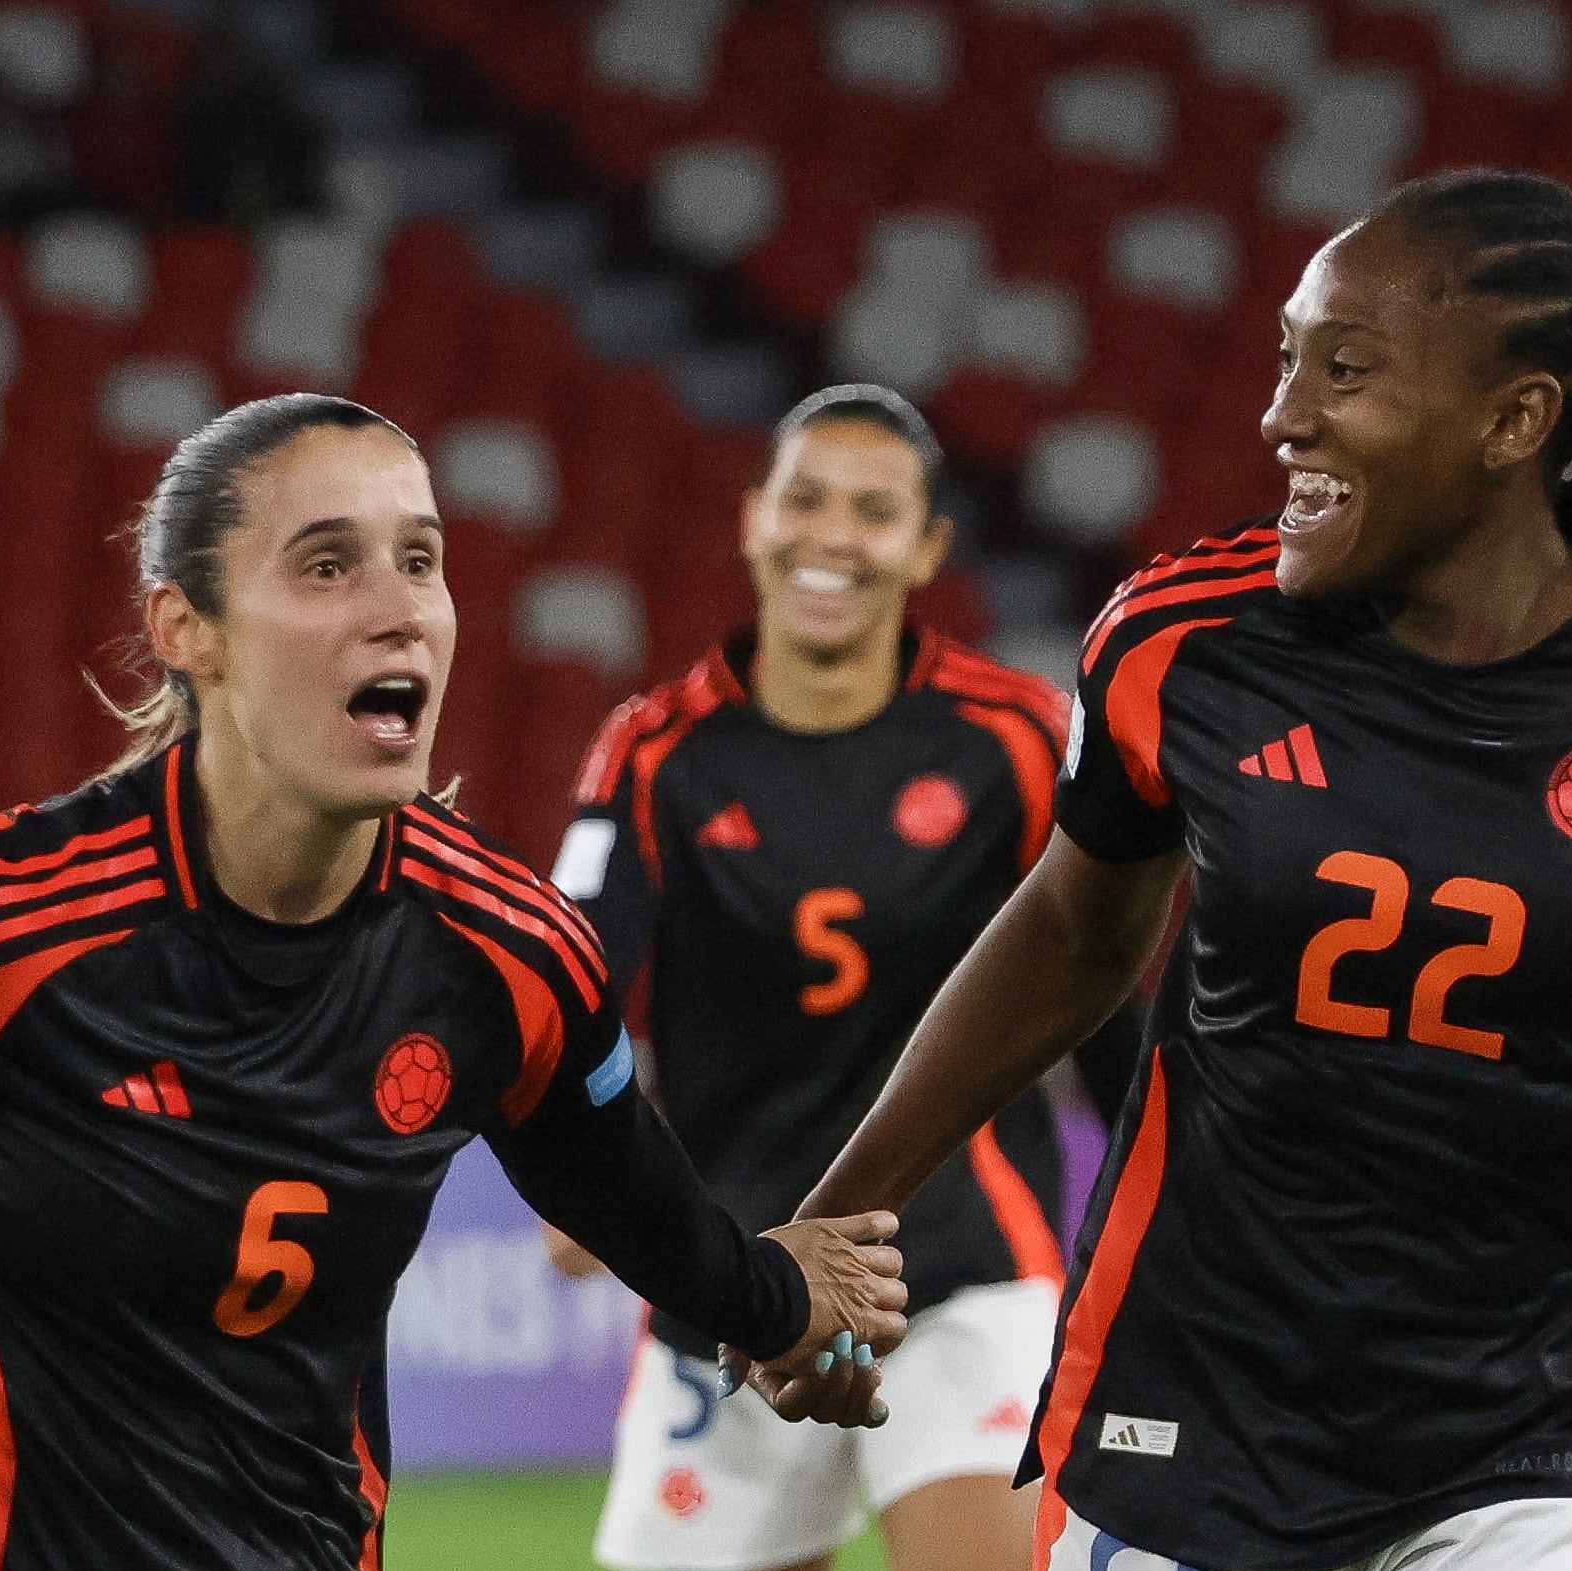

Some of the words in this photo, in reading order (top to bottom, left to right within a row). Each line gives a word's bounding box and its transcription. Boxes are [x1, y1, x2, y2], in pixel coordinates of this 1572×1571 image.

[793, 886, 871, 1017] 5
[1295, 850, 1526, 1059] 22
[213, 1179, 329, 1338] 6
